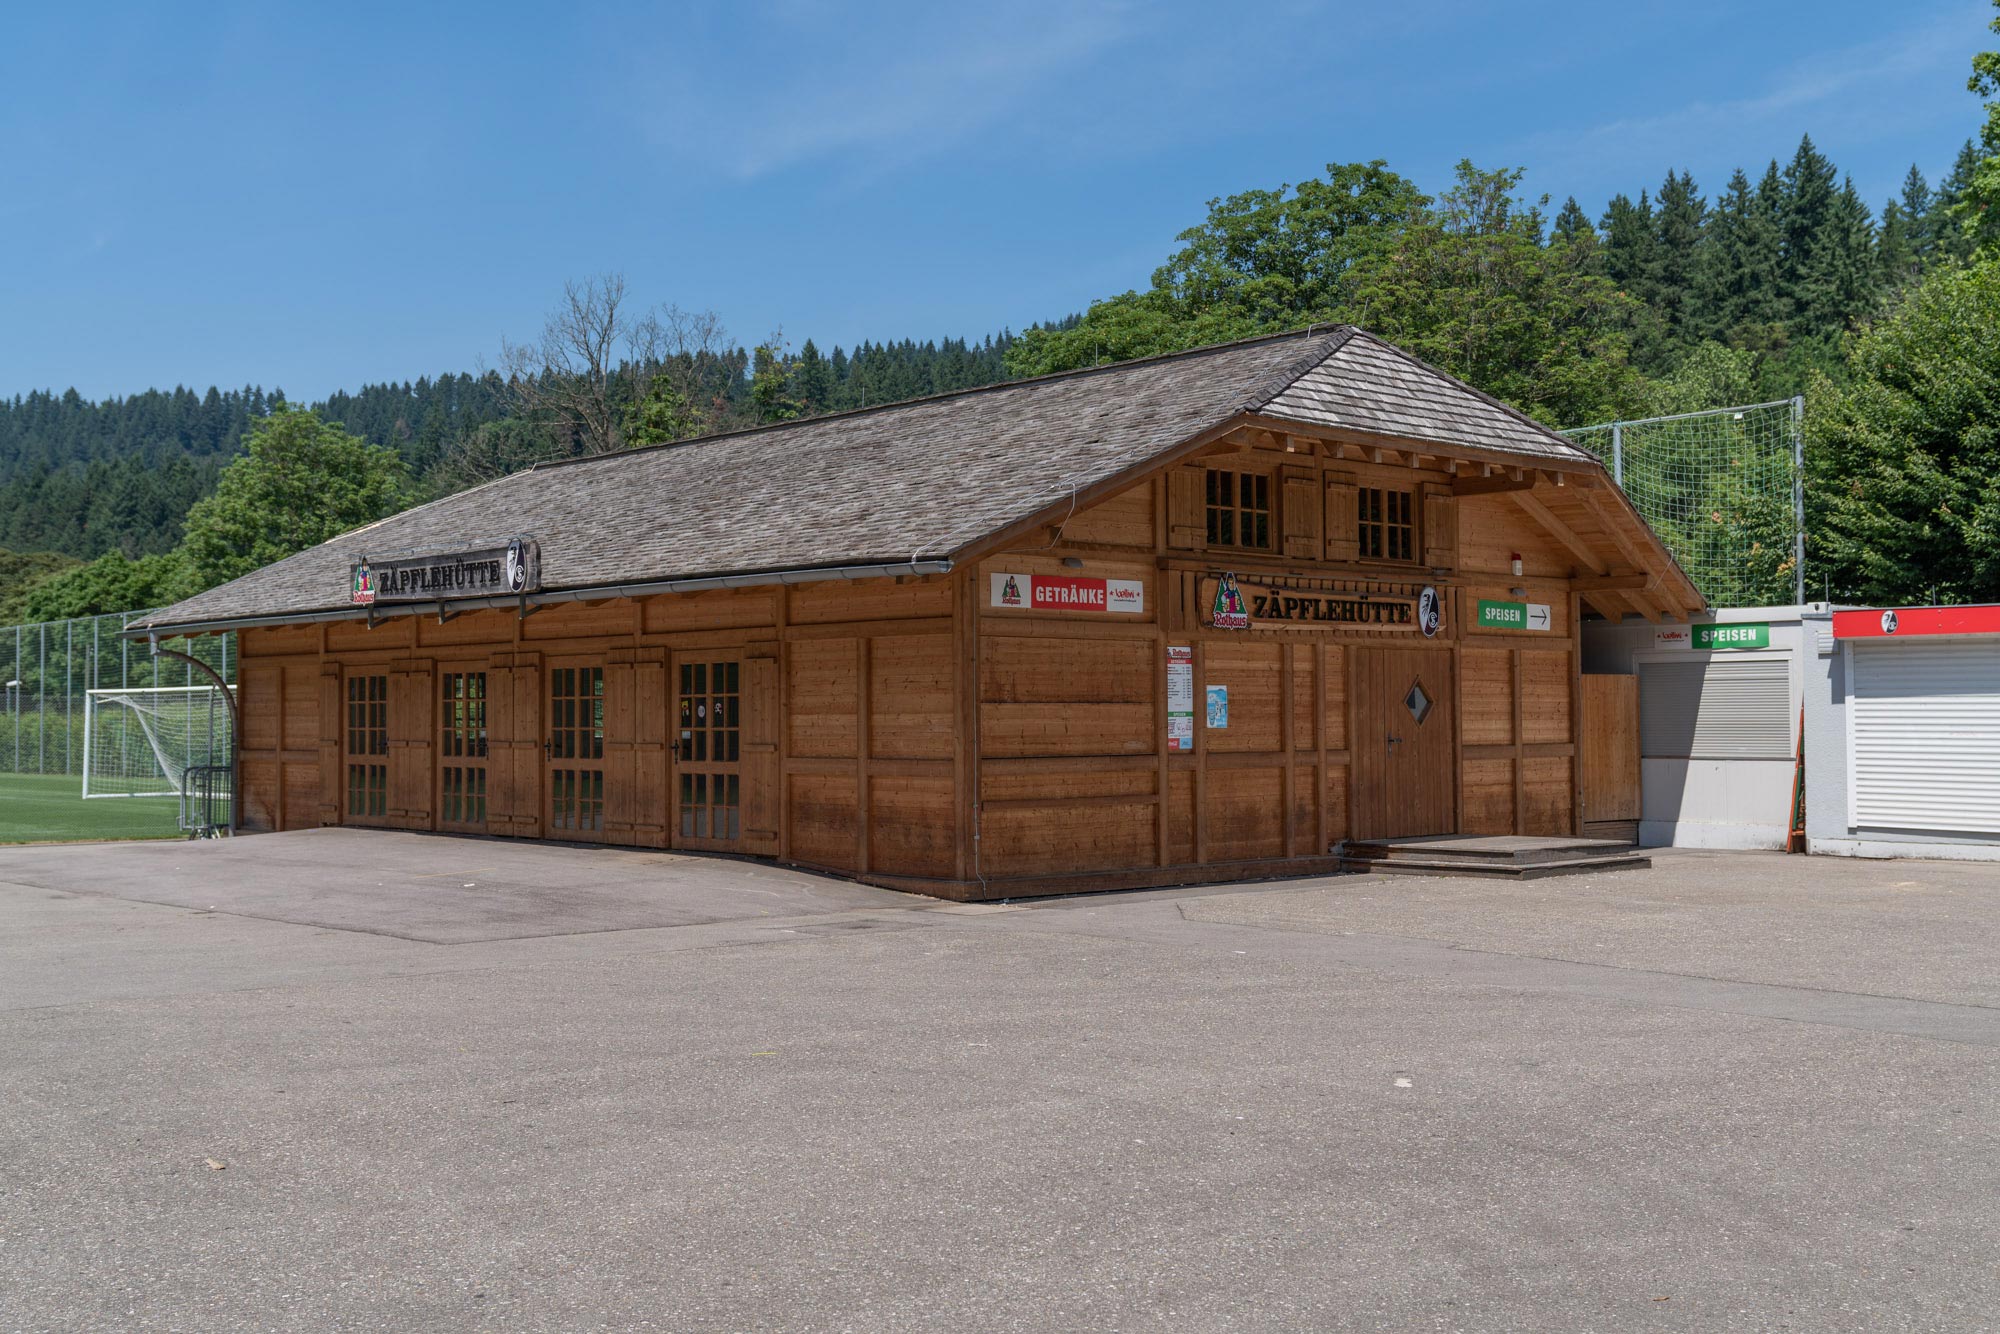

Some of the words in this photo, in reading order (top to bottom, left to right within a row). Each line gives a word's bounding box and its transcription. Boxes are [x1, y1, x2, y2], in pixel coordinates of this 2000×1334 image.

[379, 557, 501, 593] ZÄPFLEHÜTTE
[1036, 584, 1104, 605] GETRÄNKE
[1253, 591, 1412, 624] ZÄPFLEHÜTTE
[1485, 607, 1520, 622] SPEISEN
[1215, 613, 1247, 628] Rothaus
[1701, 628, 1757, 642] SPEISEN
